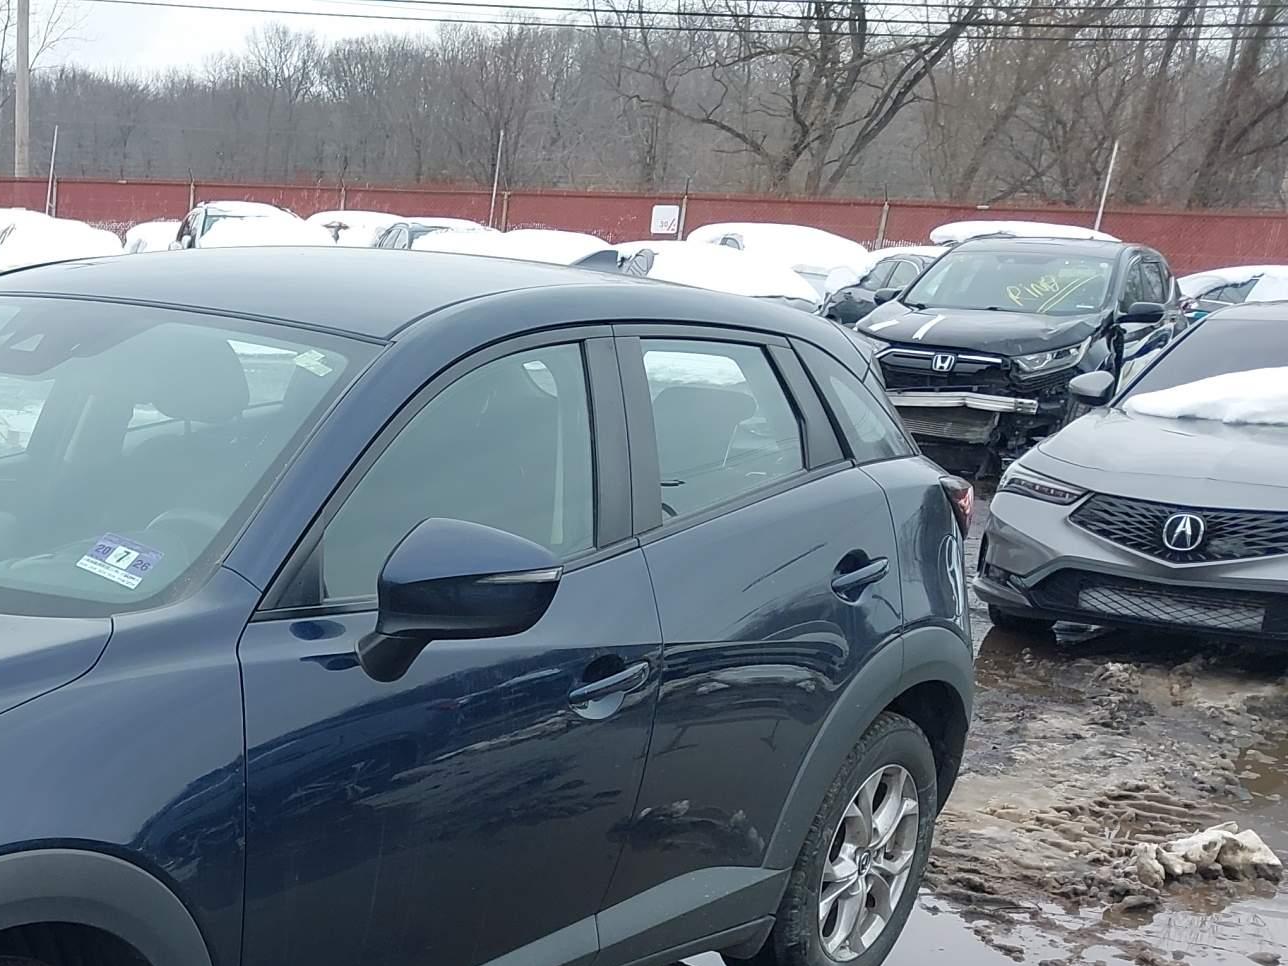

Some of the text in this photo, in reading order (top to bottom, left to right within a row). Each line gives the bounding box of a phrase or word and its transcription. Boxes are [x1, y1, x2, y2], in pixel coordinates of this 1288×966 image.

[95, 544, 112, 555] 20
[116, 550, 131, 563] 7
[132, 559, 151, 571] 26
